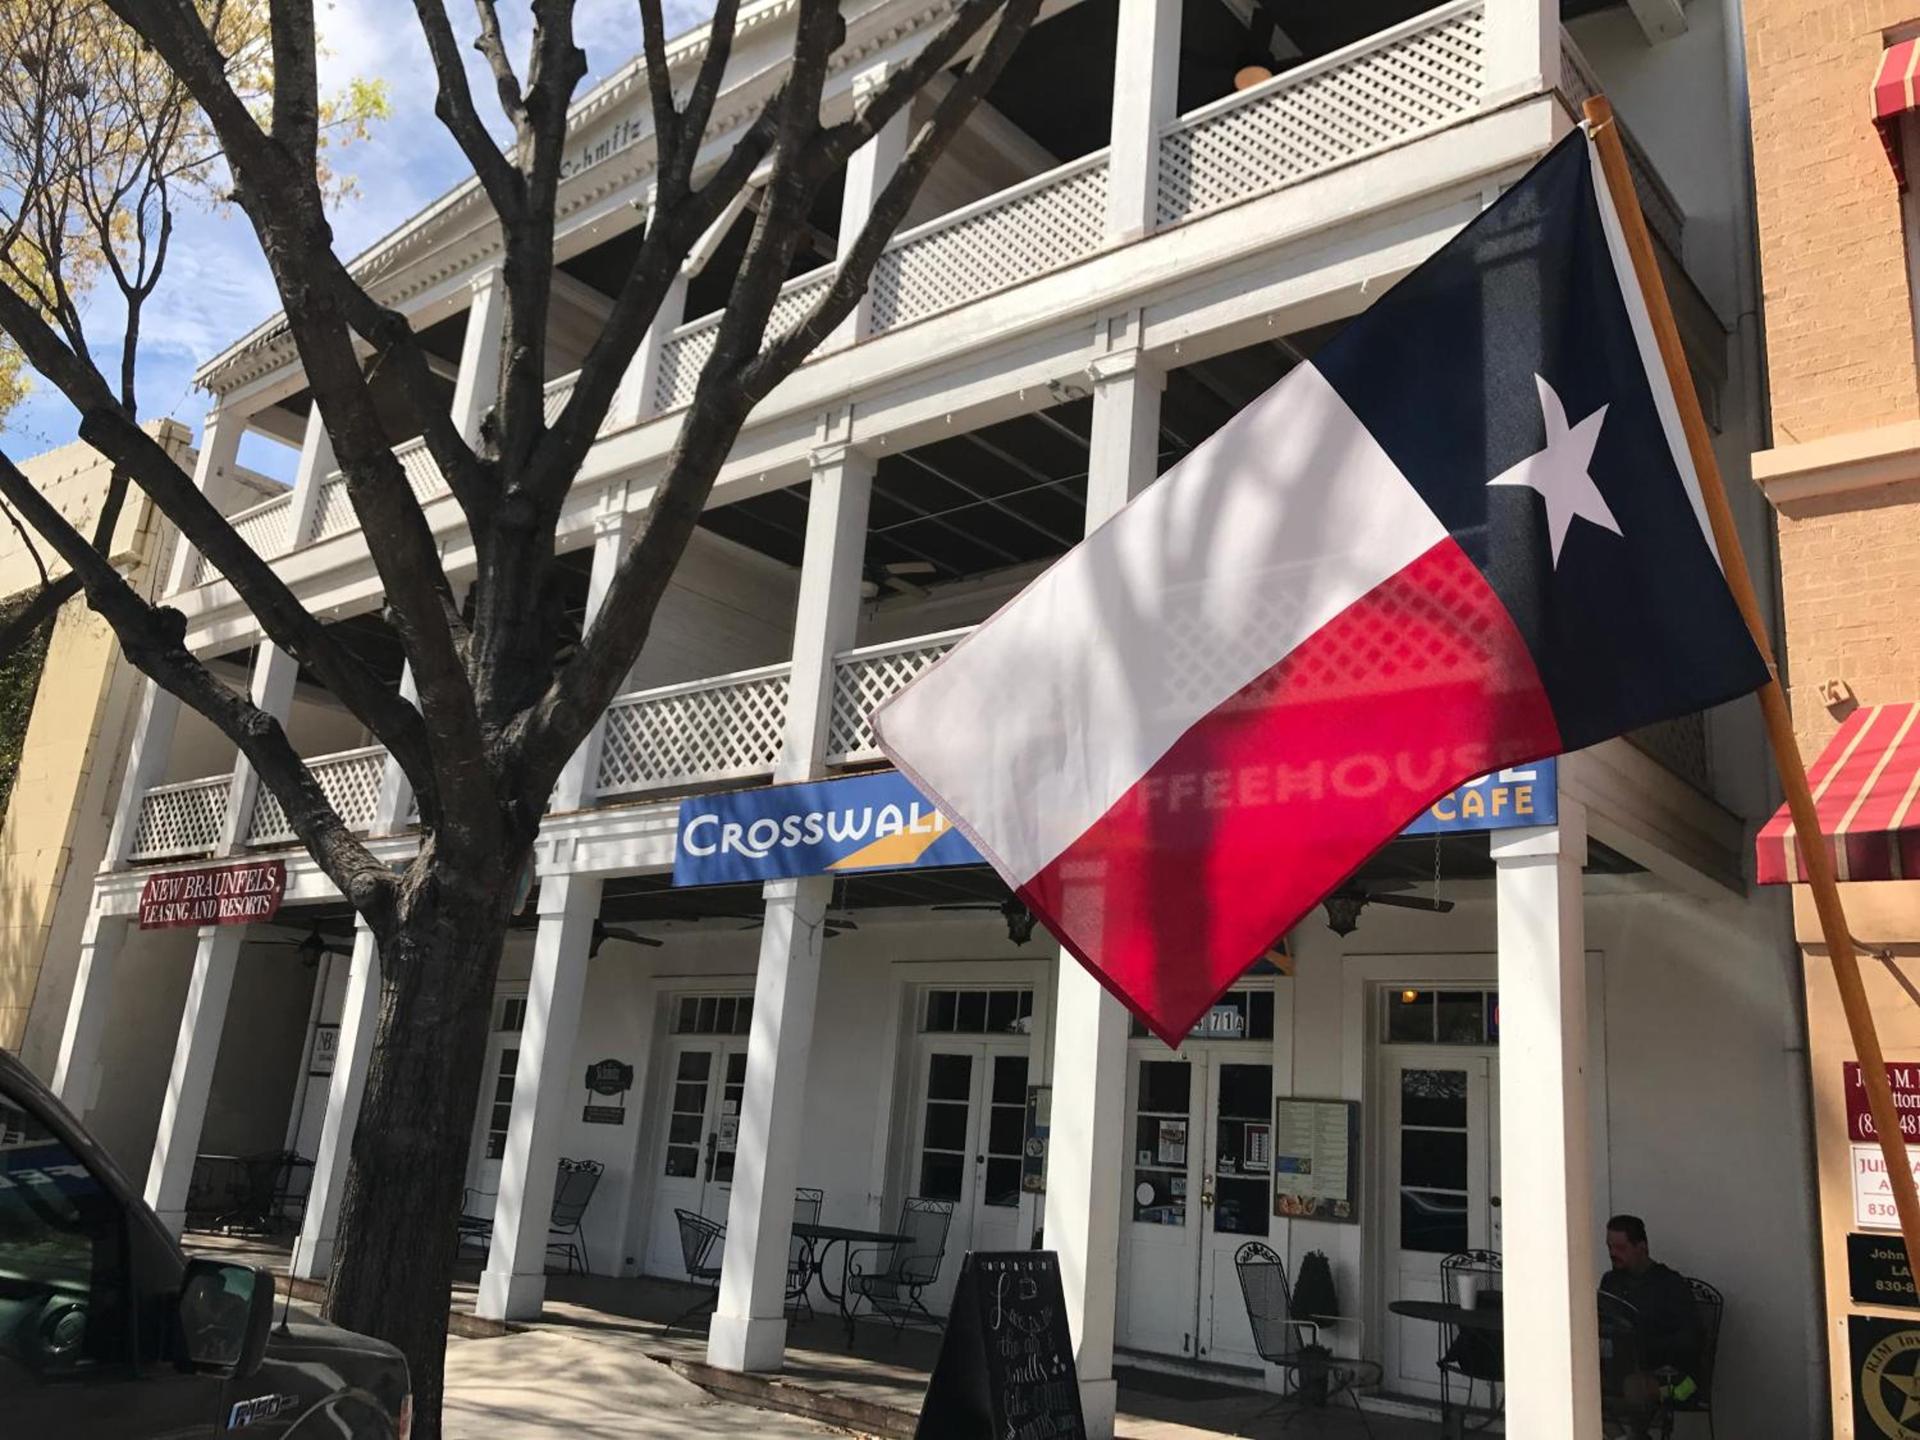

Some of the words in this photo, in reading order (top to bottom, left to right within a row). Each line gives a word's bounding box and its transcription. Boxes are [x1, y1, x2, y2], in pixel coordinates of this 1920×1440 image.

[1431, 786, 1534, 821] CAFE
[147, 877, 185, 903] NEW
[183, 866, 278, 899] BRAUNFELS
[143, 901, 191, 924] LEASING
[190, 900, 218, 920] AND
[218, 894, 273, 918] RESORTS
[1894, 1068, 1915, 1088] M.
[1870, 1248, 1905, 1260] John
